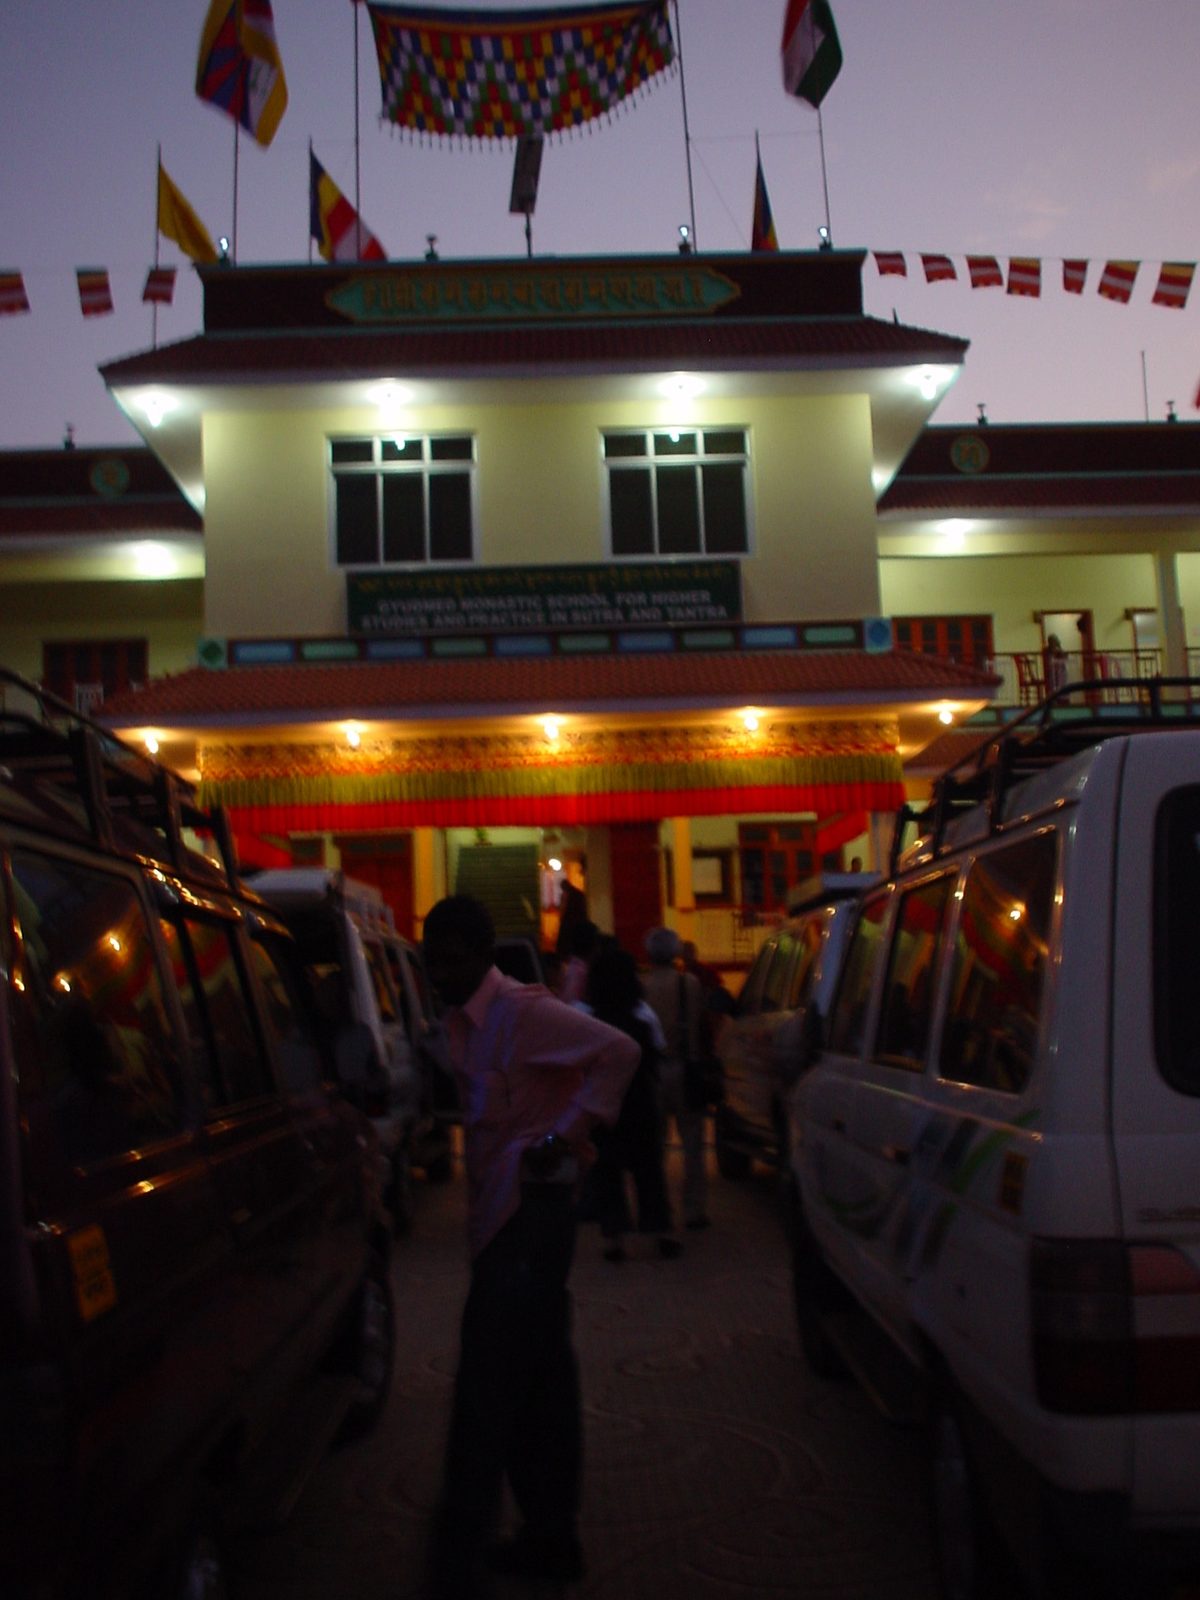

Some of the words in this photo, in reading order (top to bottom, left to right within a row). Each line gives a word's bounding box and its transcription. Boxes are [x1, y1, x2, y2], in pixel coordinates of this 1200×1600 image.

[547, 592, 609, 608] SCHOOL
[615, 590, 647, 605] FOR
[432, 612, 466, 628] AND
[630, 606, 661, 622] AND
